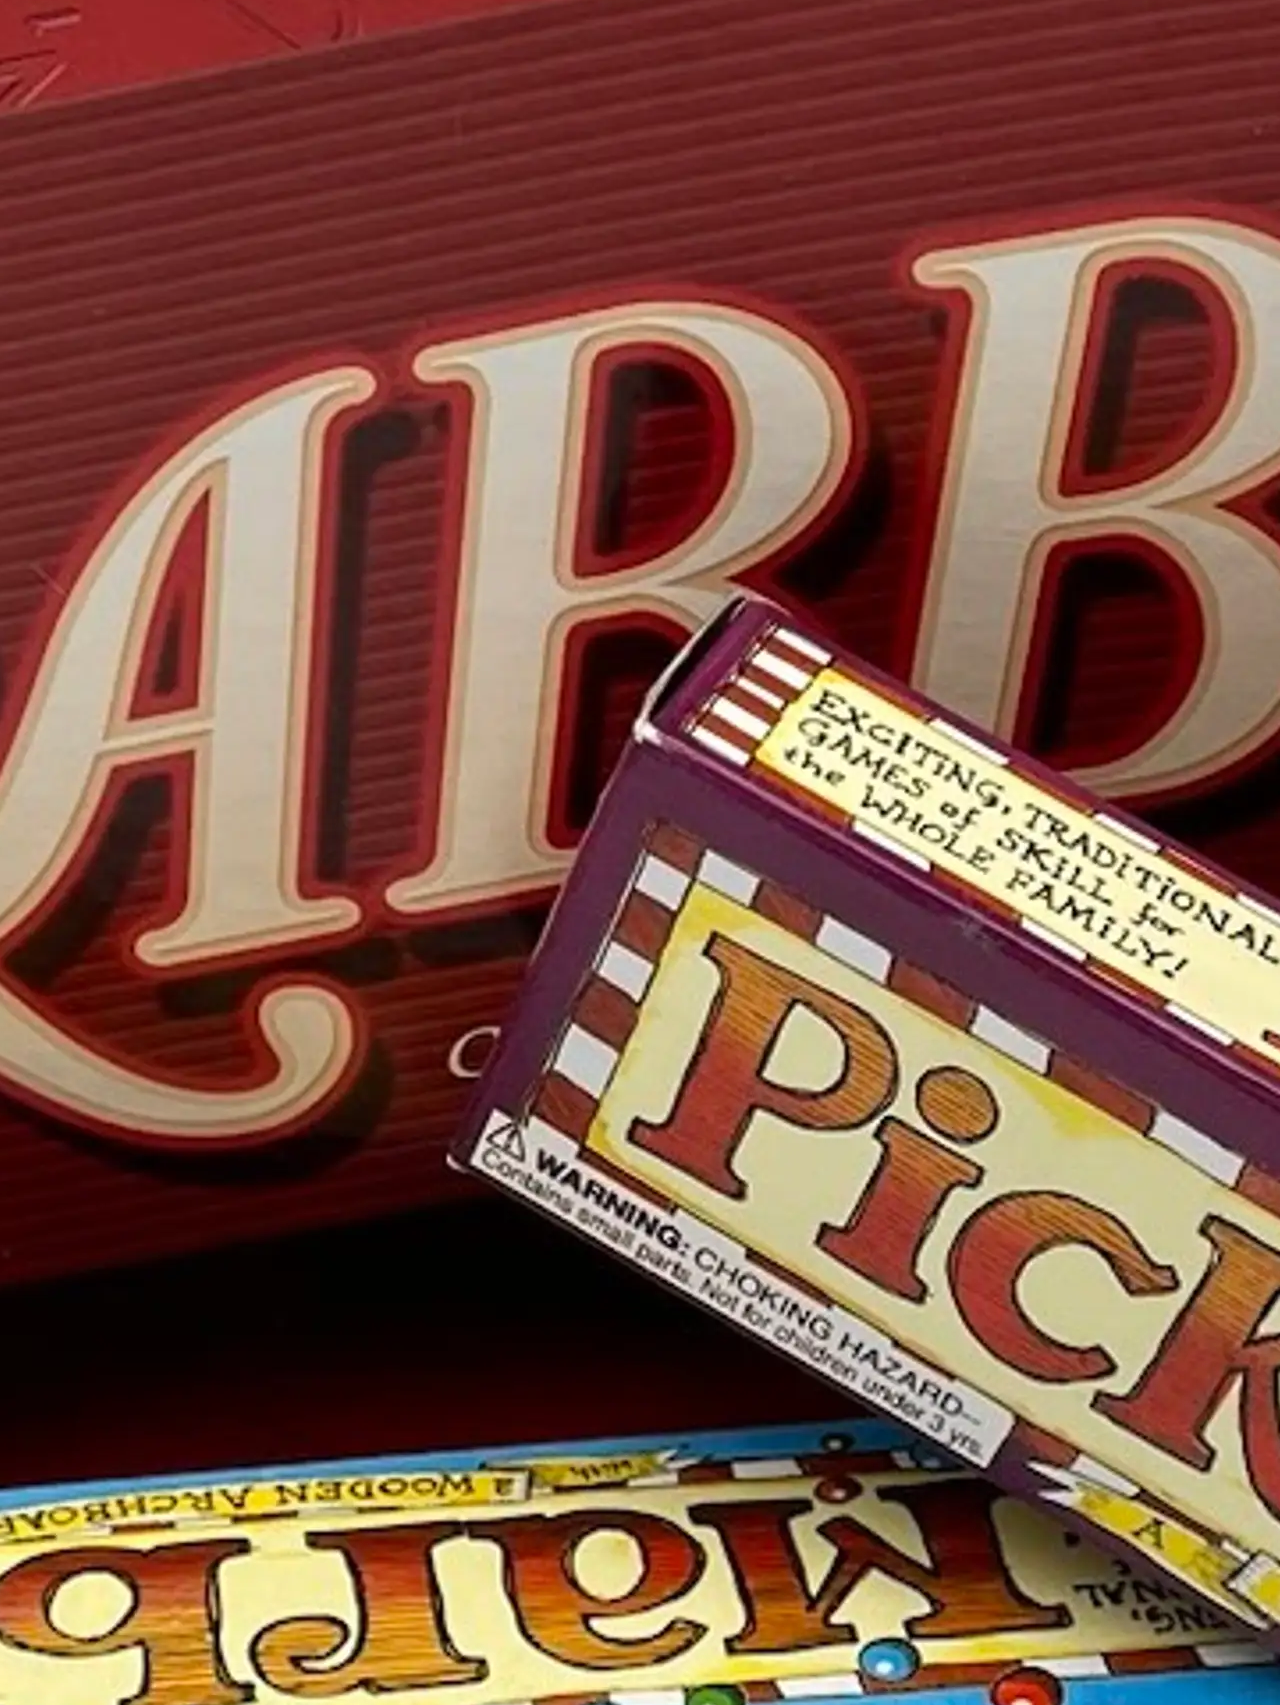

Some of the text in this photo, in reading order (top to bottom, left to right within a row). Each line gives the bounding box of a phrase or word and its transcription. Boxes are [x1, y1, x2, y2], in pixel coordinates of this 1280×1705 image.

[782, 743, 846, 787] the
[860, 792, 996, 875] WHOLE
[796, 716, 925, 800] GAMES
[939, 800, 980, 835] of
[1131, 901, 1186, 939] for
[481, 1147, 573, 1216] Contains
[576, 1205, 636, 1252] small
[699, 1275, 742, 1312] Not
[740, 1300, 774, 1330] for
[773, 1316, 860, 1385] children
[861, 1377, 925, 1423] under
[927, 1414, 946, 1435] 3
[536, 1145, 691, 1259] WARNING:
[694, 1245, 836, 1343] CHOKING
[273, 1472, 477, 1507] WOODEN
[1131, 1517, 1166, 1551] A
